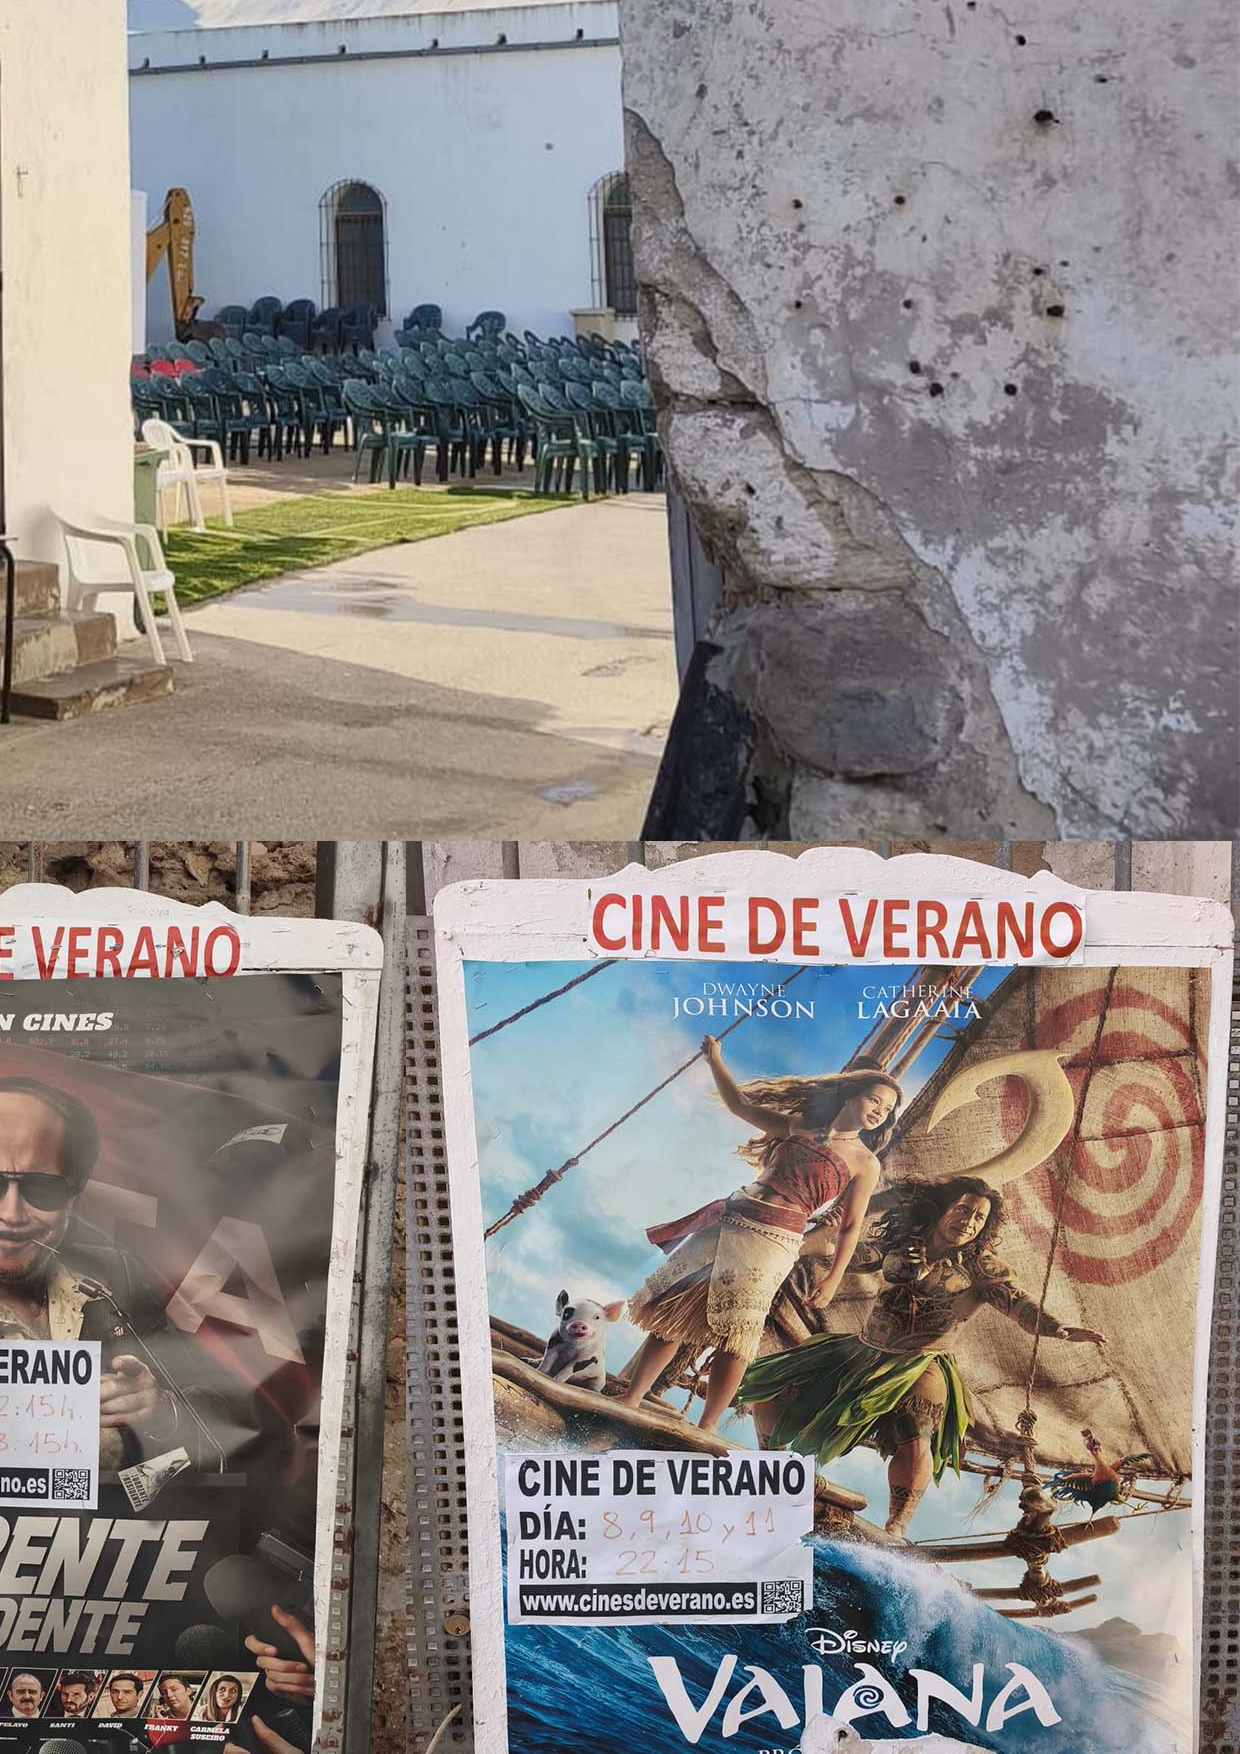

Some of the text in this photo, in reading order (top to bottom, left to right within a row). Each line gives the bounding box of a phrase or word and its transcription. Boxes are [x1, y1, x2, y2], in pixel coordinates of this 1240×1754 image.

[592, 893, 1084, 959] CINE DE VERANO
[31, 925, 241, 979] VERANO
[703, 982, 786, 997] DWAYNE
[862, 984, 974, 999] CATHERINE
[672, 996, 816, 1020] JOHNSON
[22, 1012, 114, 1031] CINES
[518, 1458, 805, 1496] CINE DE VERANO
[519, 1504, 587, 1541] DÍA:
[519, 1548, 587, 1579] HORA:
[522, 1588, 755, 1612] www.cinesdeverano.es
[647, 1654, 1062, 1744] VAIANA
[144, 1724, 179, 1732] FRANKY
[190, 1725, 231, 1734] CARMELA
